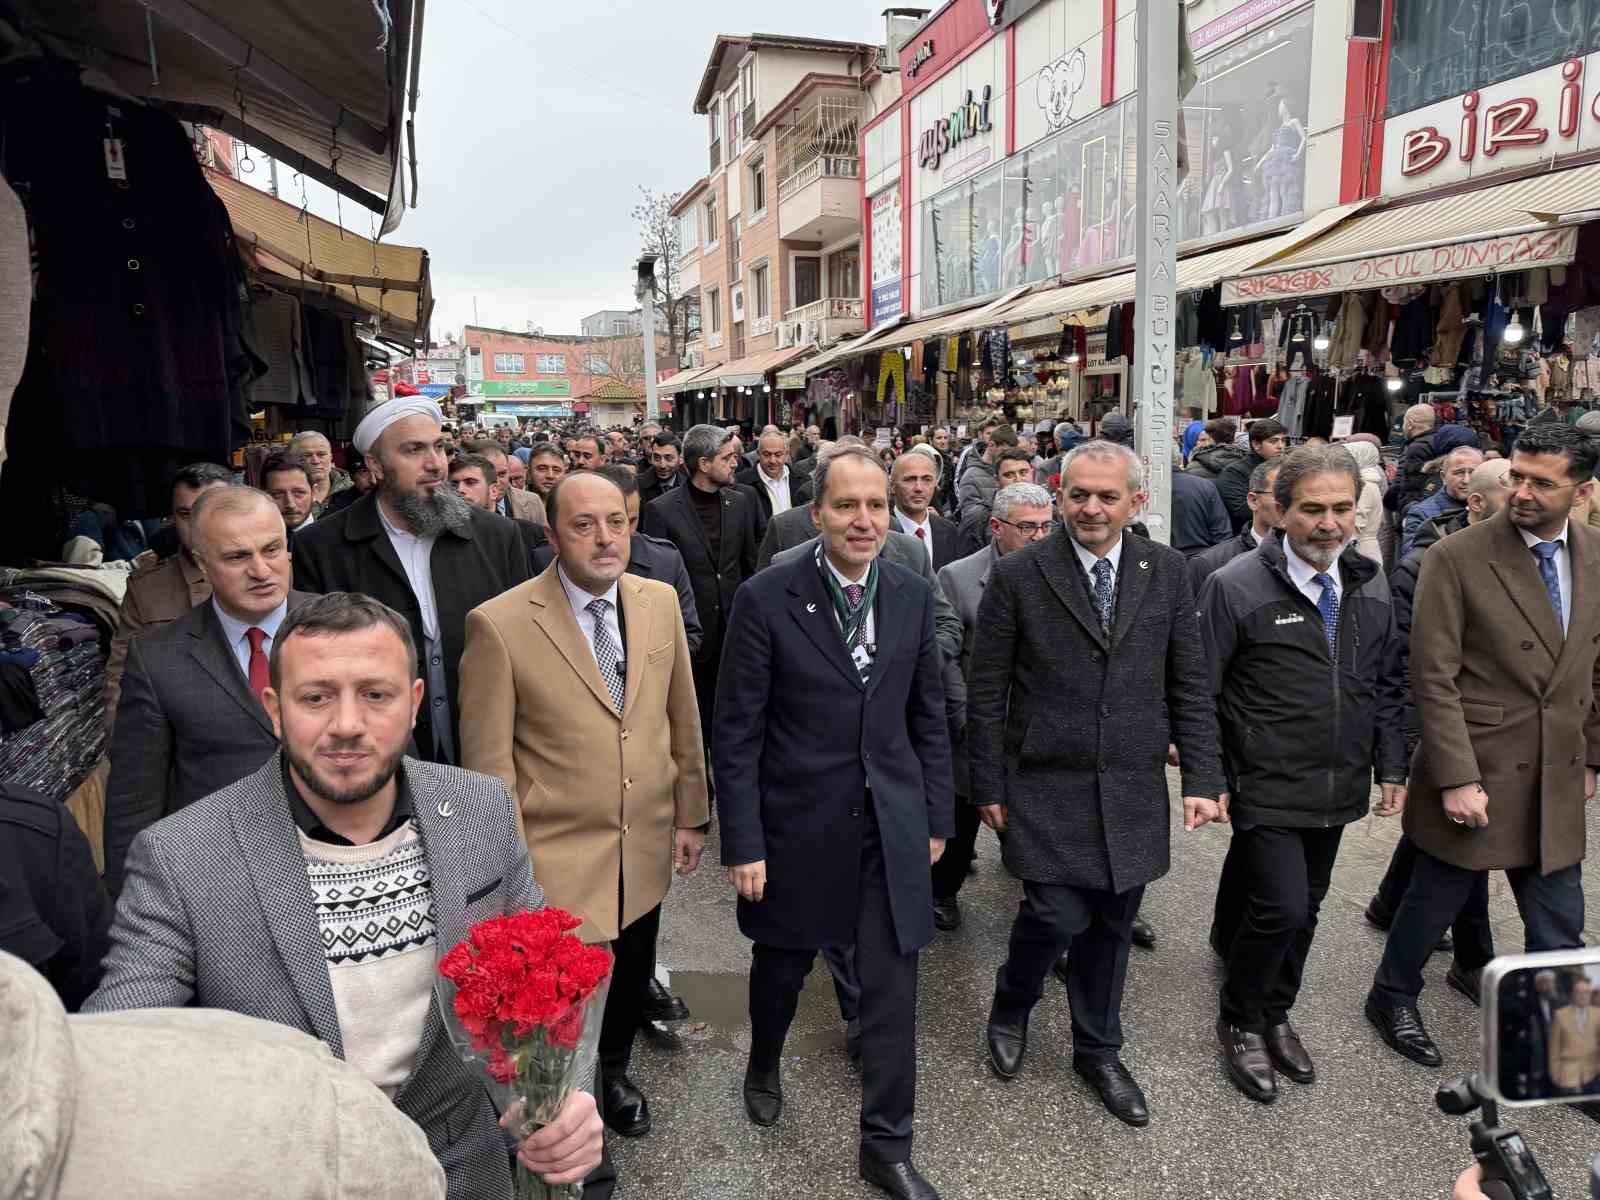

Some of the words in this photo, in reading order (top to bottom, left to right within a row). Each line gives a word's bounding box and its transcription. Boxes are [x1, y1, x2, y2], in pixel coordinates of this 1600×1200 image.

[1401, 57, 1600, 177] BİRİ
[1152, 119, 1172, 281] SAKARYA
[1352, 252, 1421, 283] OKUL
